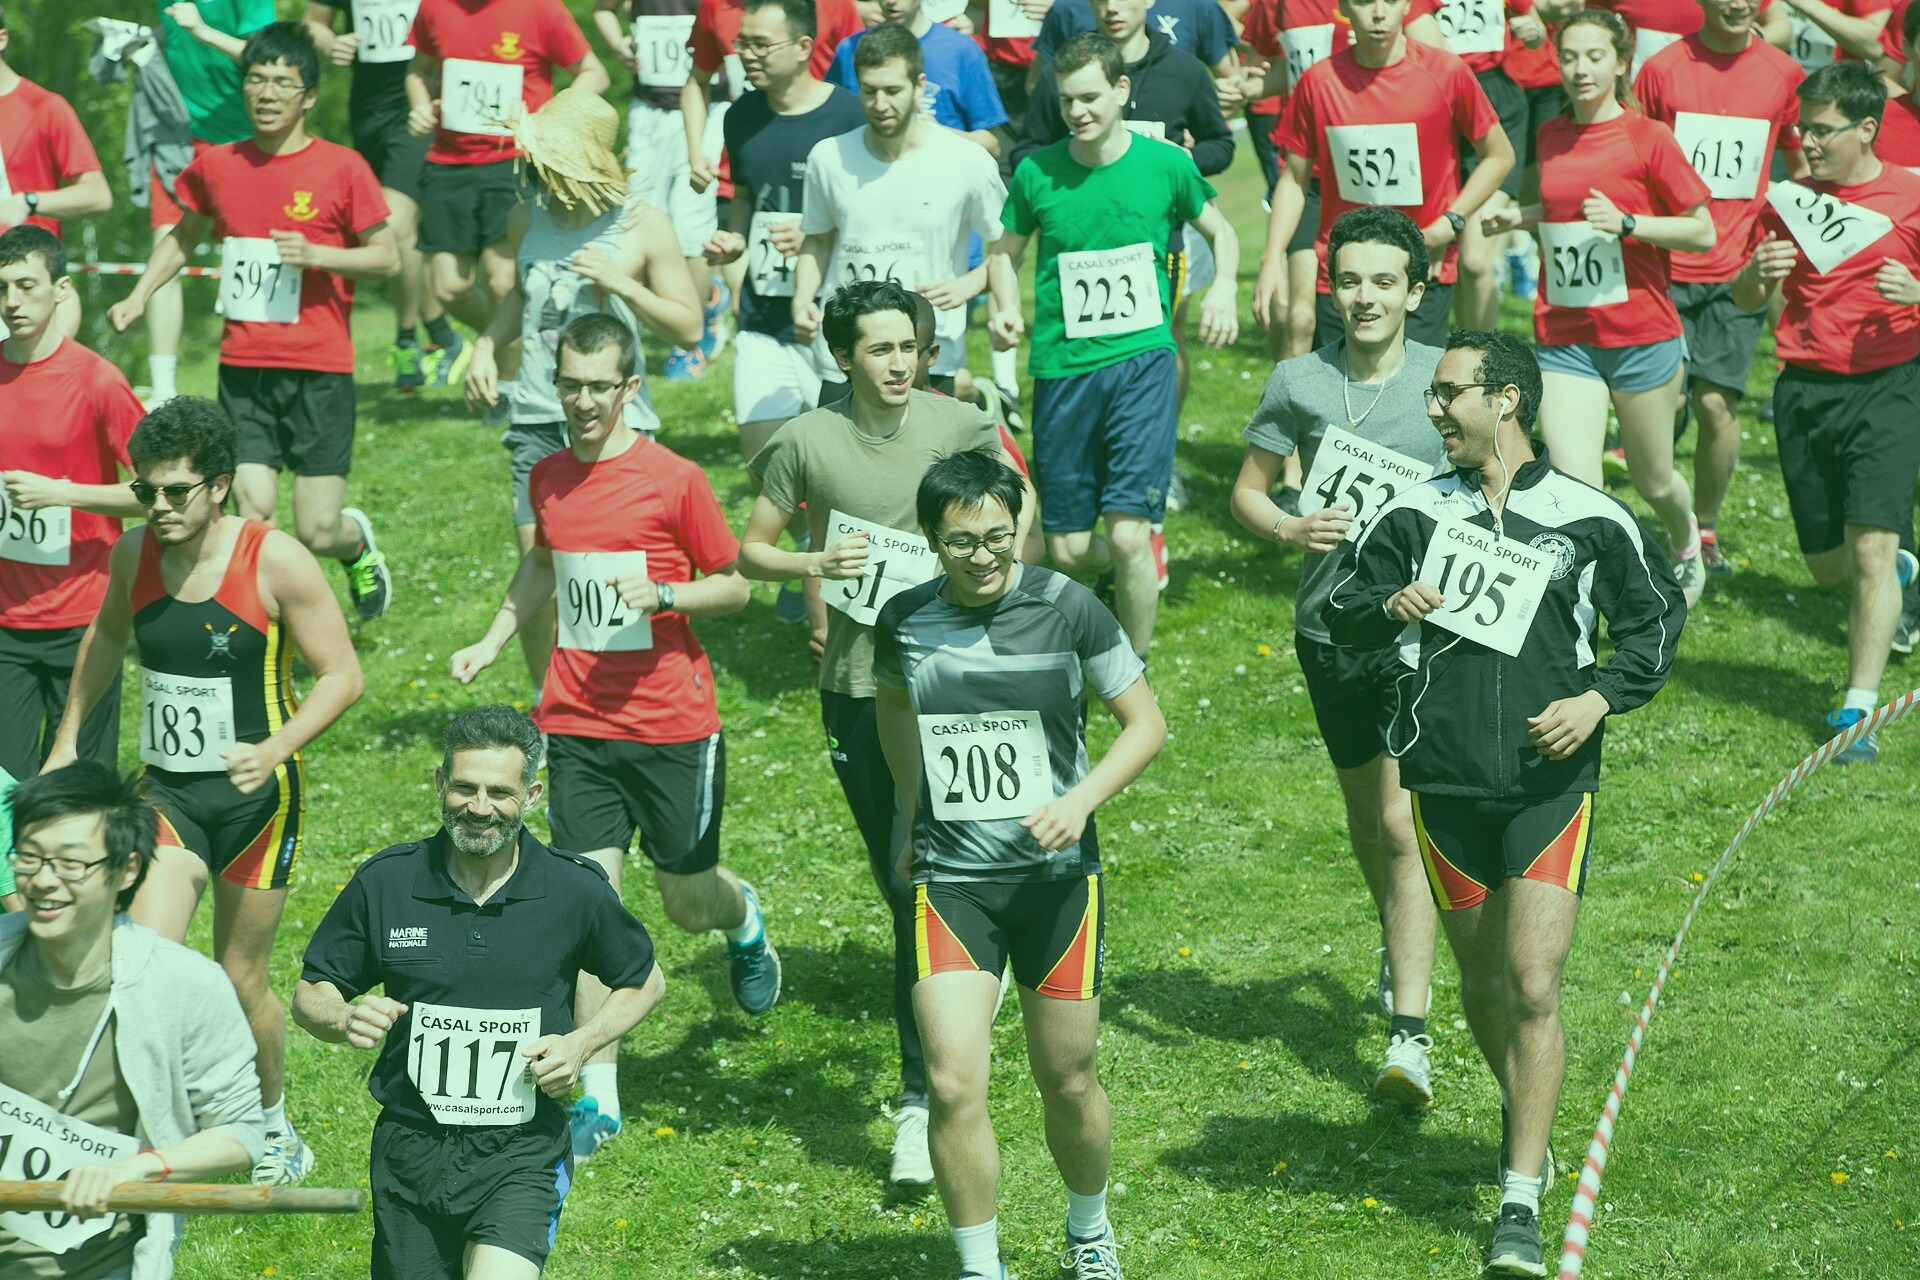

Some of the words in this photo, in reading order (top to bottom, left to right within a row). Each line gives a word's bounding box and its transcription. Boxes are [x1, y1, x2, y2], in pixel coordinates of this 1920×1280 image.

[1348, 148, 1399, 187] 552
[1692, 137, 1744, 179] 613
[231, 260, 282, 302] 597
[1068, 260, 1103, 271] CASAL
[1107, 252, 1142, 268] SPORT
[1554, 242, 1603, 288] 526
[1074, 274, 1137, 324] 223
[1333, 439, 1376, 465] CASAL
[1379, 458, 1421, 482] SPORT
[883, 537, 928, 557] SPORT
[1447, 526, 1490, 553] CASAL
[1493, 546, 1541, 572] SPORT
[567, 577, 625, 628] 902
[1440, 552, 1517, 627] 195
[176, 685, 217, 698] SPORT
[147, 700, 205, 758] 183
[931, 722, 979, 736] CASAL
[982, 719, 1030, 732] SPORT
[939, 742, 1021, 803] 208
[388, 939, 428, 949] NATIONALE
[389, 926, 429, 939] MARINE
[421, 1016, 473, 1032] CASAL
[479, 1021, 531, 1034] SPORT
[413, 1032, 519, 1101] 1117
[0, 1100, 54, 1135] CASAL
[59, 1127, 120, 1160] SPORT
